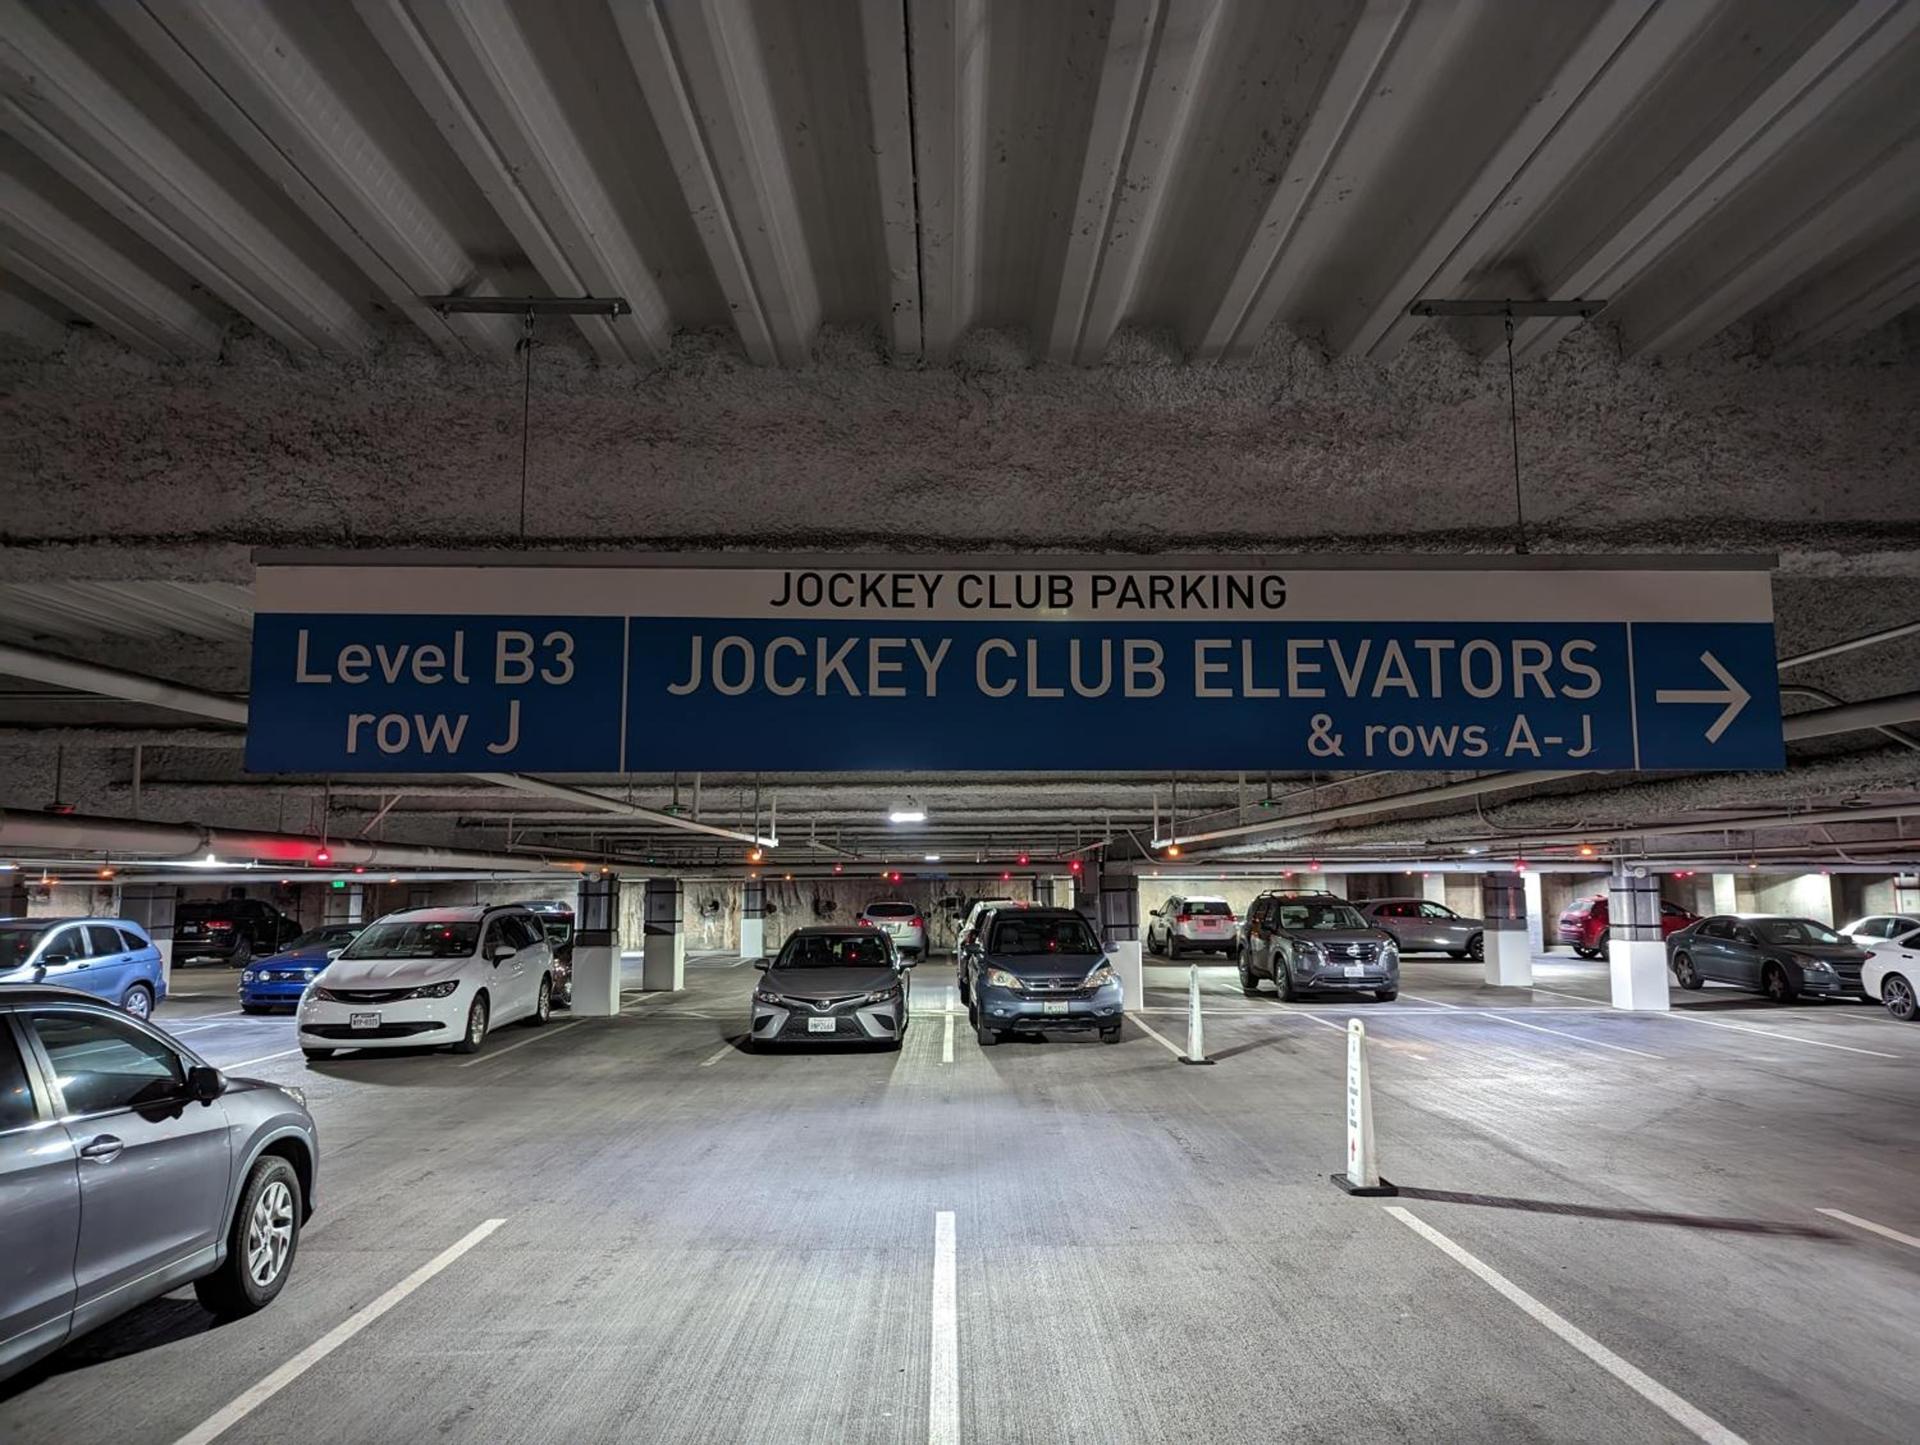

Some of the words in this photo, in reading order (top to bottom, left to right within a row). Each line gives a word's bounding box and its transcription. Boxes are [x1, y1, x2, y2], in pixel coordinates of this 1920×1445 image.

[770, 572, 945, 609] JOCKEY
[957, 573, 1074, 609] CLUB
[1091, 574, 1287, 610] PARKING
[296, 629, 469, 684] Level
[495, 631, 574, 684] B3
[667, 636, 951, 697] JOCKEY
[976, 638, 1165, 698] CLUB
[1195, 639, 1601, 698] ELEVATORS
[347, 713, 468, 753] row
[487, 700, 520, 754] J
[1307, 714, 1344, 757] &
[1365, 723, 1488, 757] rows
[1505, 714, 1592, 757] A-J
